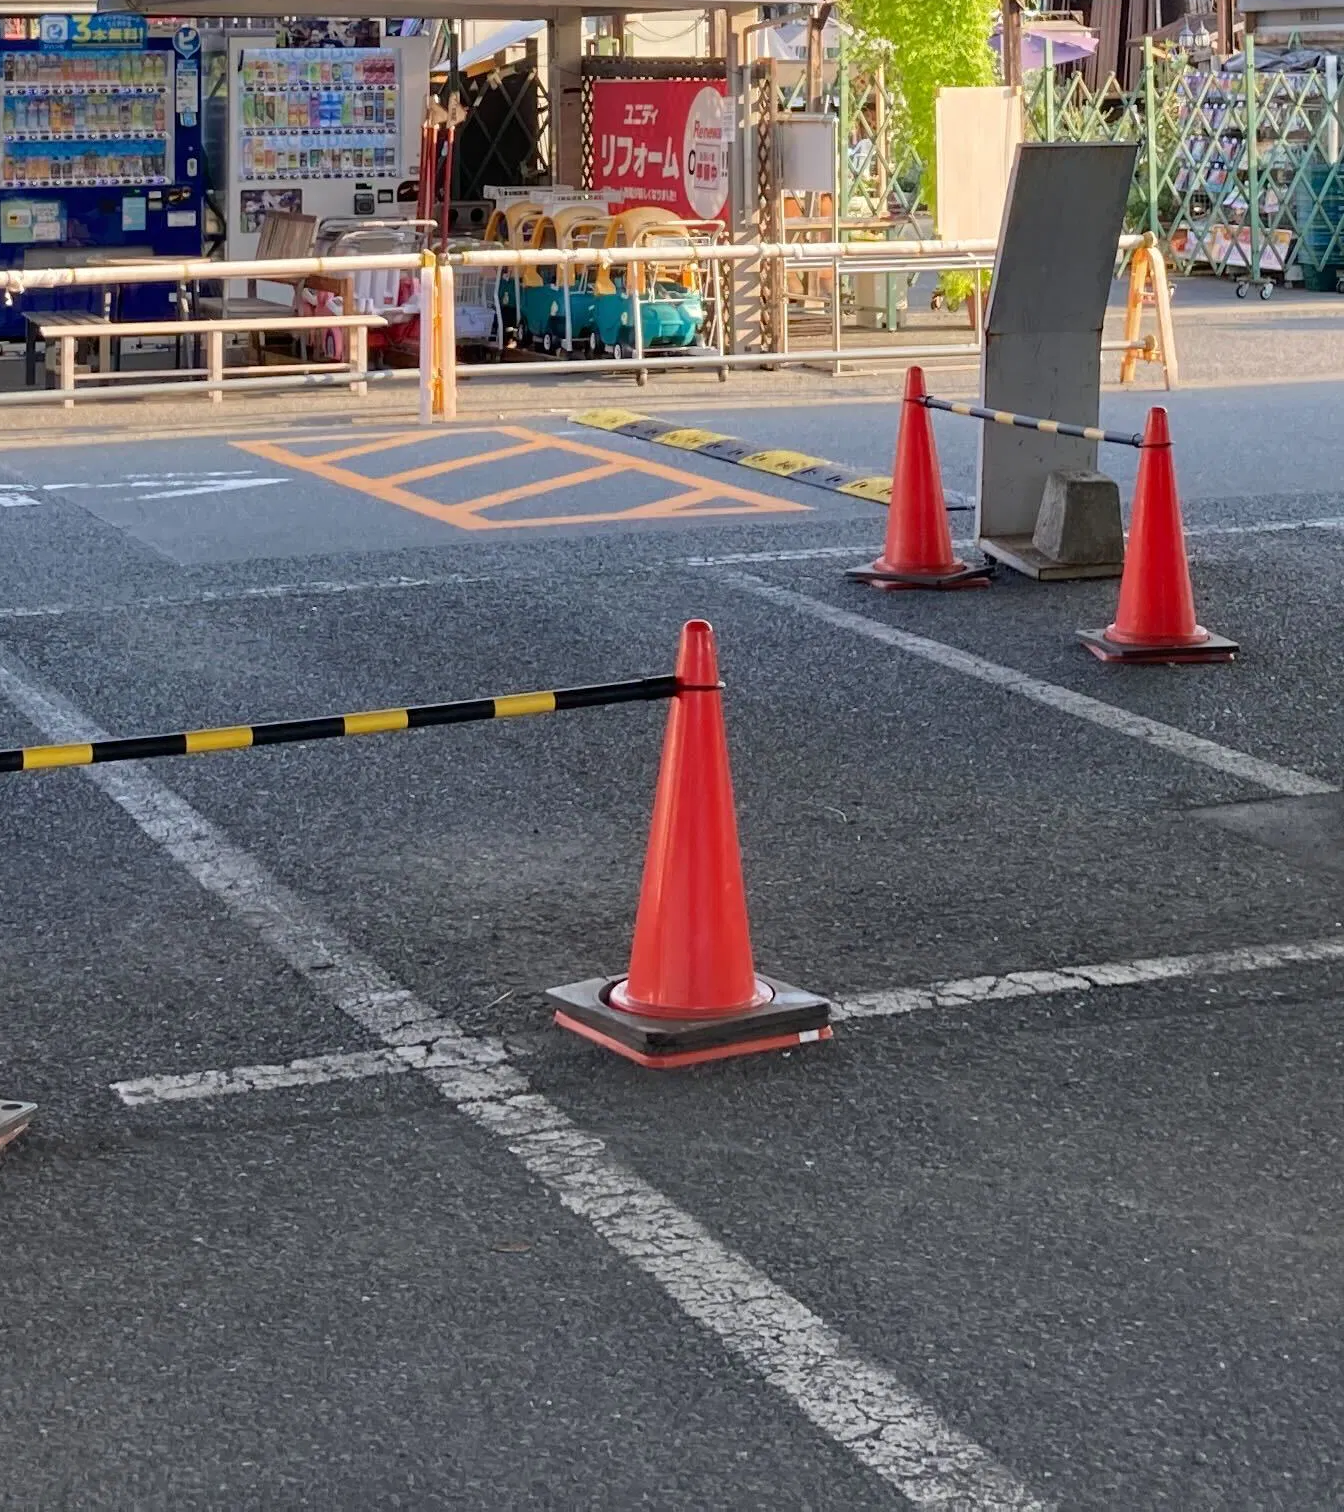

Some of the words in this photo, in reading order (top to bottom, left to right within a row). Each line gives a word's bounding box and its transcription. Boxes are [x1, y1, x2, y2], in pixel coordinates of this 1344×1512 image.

[623, 103, 659, 126] ユニディ
[601, 134, 680, 179] リフォーム
